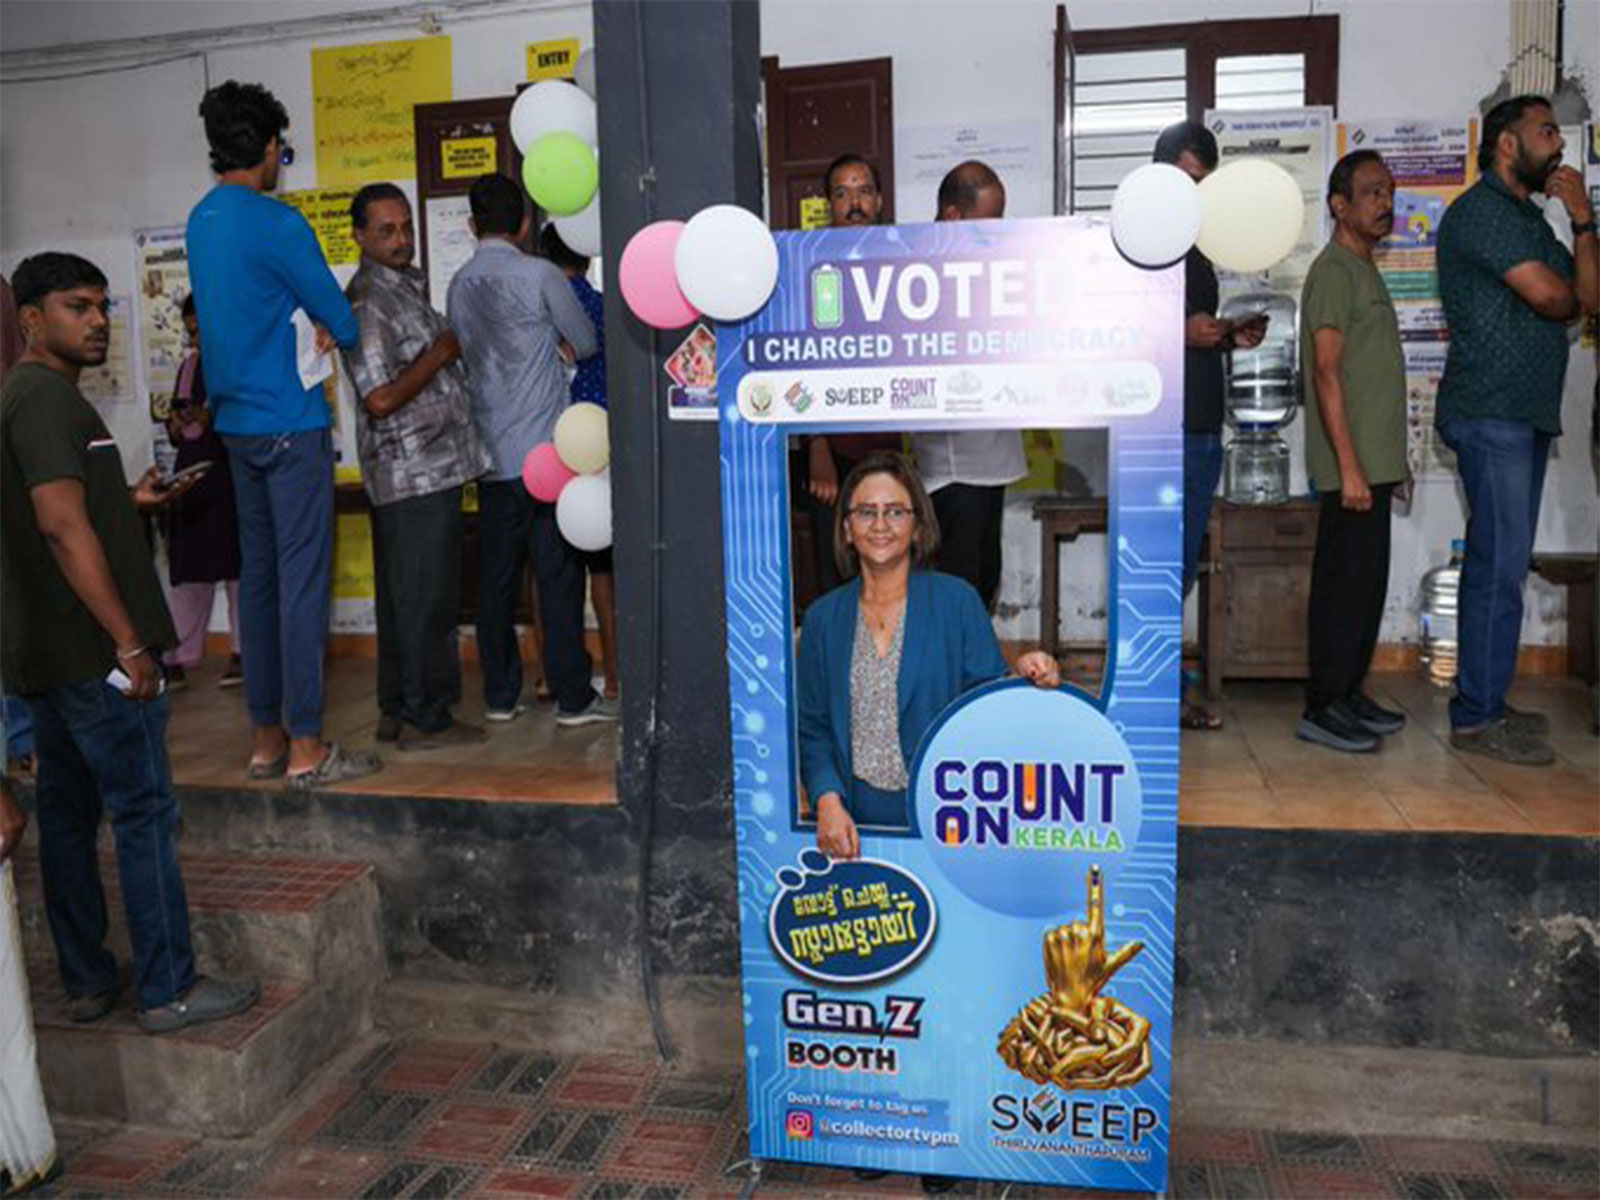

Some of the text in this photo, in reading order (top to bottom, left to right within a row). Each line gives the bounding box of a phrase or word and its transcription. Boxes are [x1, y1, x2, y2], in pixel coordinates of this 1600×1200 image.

[538, 51, 570, 68] ENTRY
[748, 326, 1146, 362] I CHARGED THE DEMCRACY
[890, 377, 937, 398] COUNT
[934, 760, 1125, 823] COUNT
[935, 805, 1009, 846] ON
[1015, 827, 1123, 849] KERALA
[785, 991, 921, 1034] Gen Z
[787, 1041, 897, 1073] BOOTH
[787, 1090, 929, 1116] Don't forget to tag us
[991, 1088, 1159, 1142] SWEEP
[820, 1119, 960, 1147] @collectortvpm
